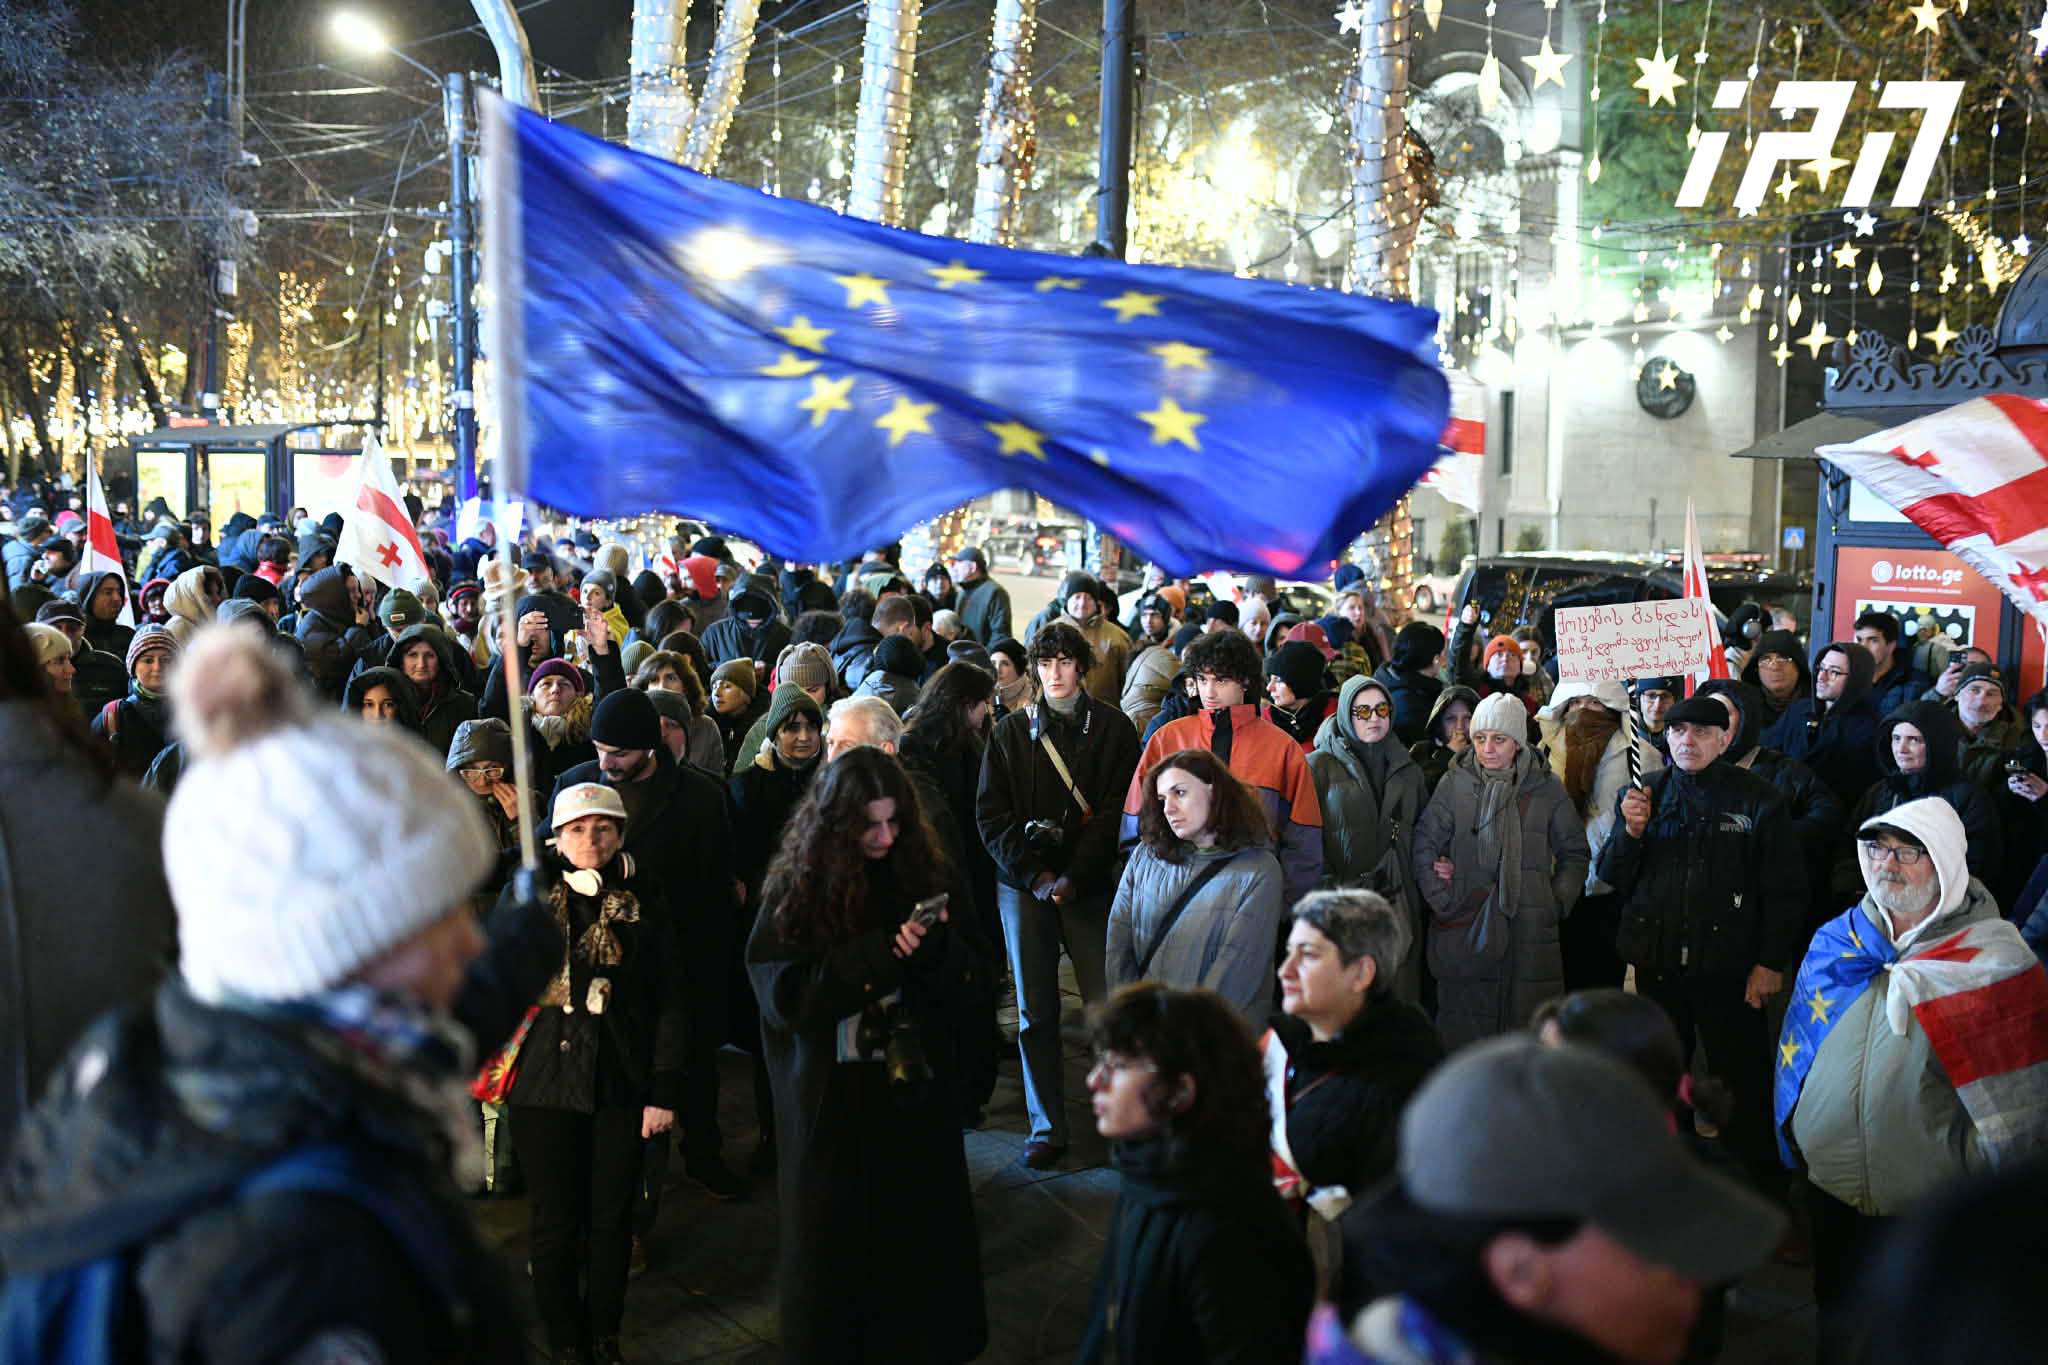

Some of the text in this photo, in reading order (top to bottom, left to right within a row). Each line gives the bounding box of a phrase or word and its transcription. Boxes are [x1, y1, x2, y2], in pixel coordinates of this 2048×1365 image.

[1895, 564, 1964, 586] lotto.ge
[1557, 602, 1703, 635] ქოცების ბანდას!
